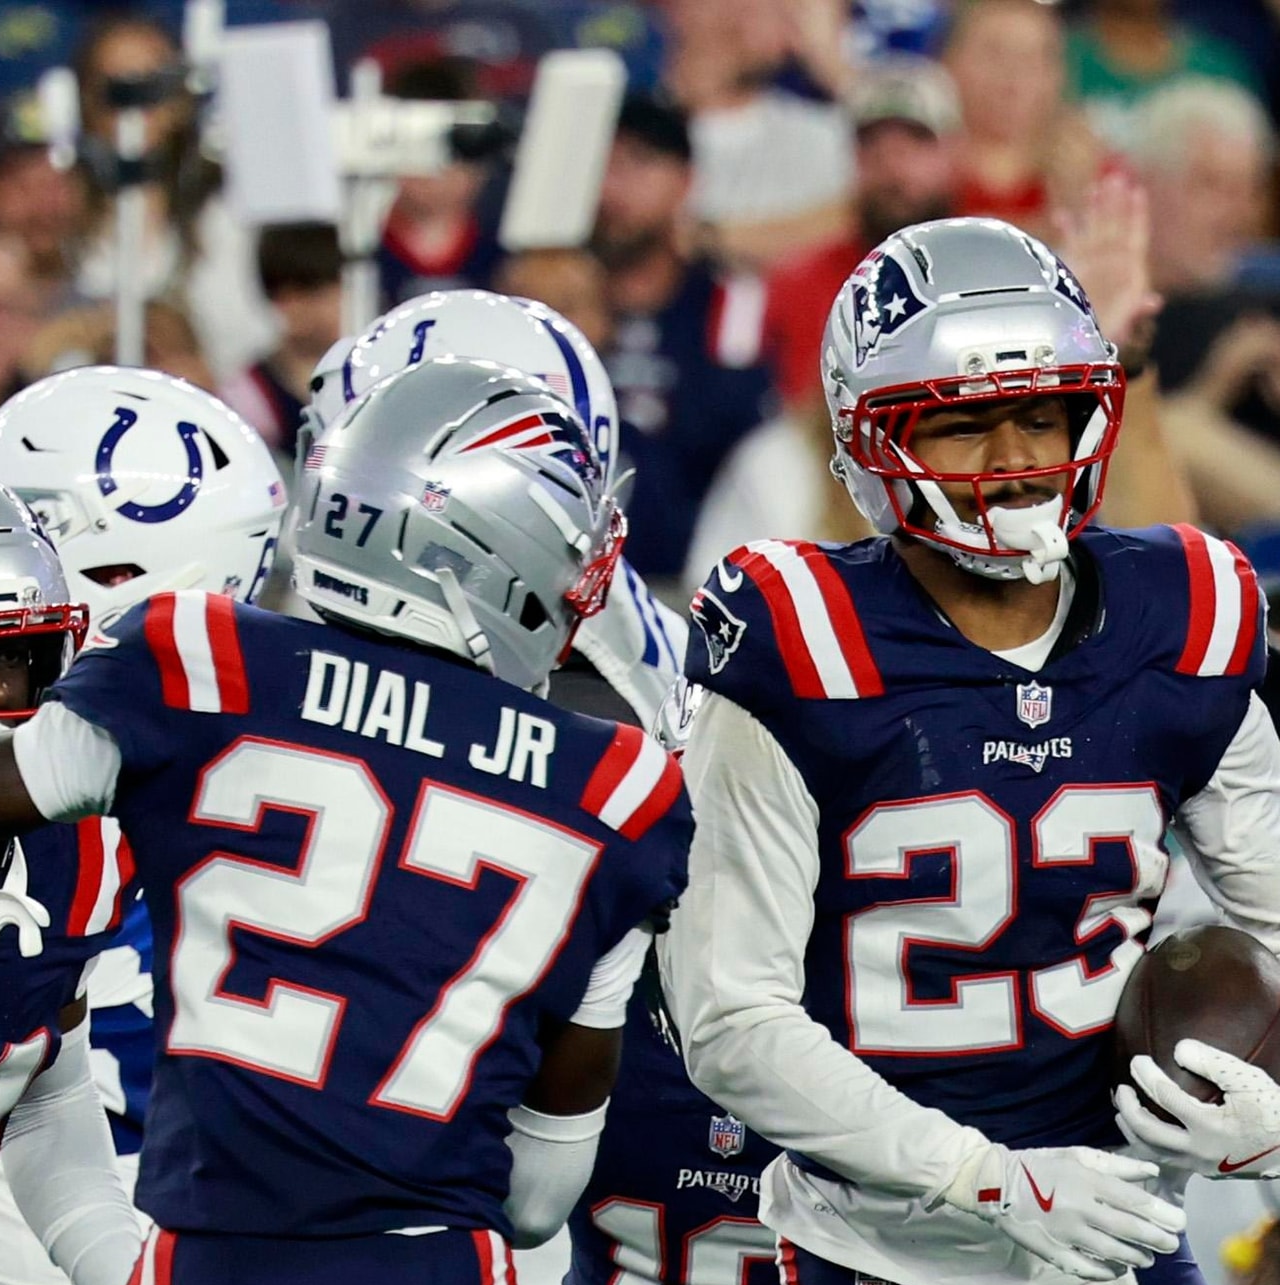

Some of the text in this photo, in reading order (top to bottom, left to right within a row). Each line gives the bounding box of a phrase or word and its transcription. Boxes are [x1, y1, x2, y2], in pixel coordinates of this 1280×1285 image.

[323, 492, 384, 548] 27
[301, 649, 557, 790] DIAL JR
[166, 734, 606, 1123] 27
[840, 780, 1170, 1058] 23
